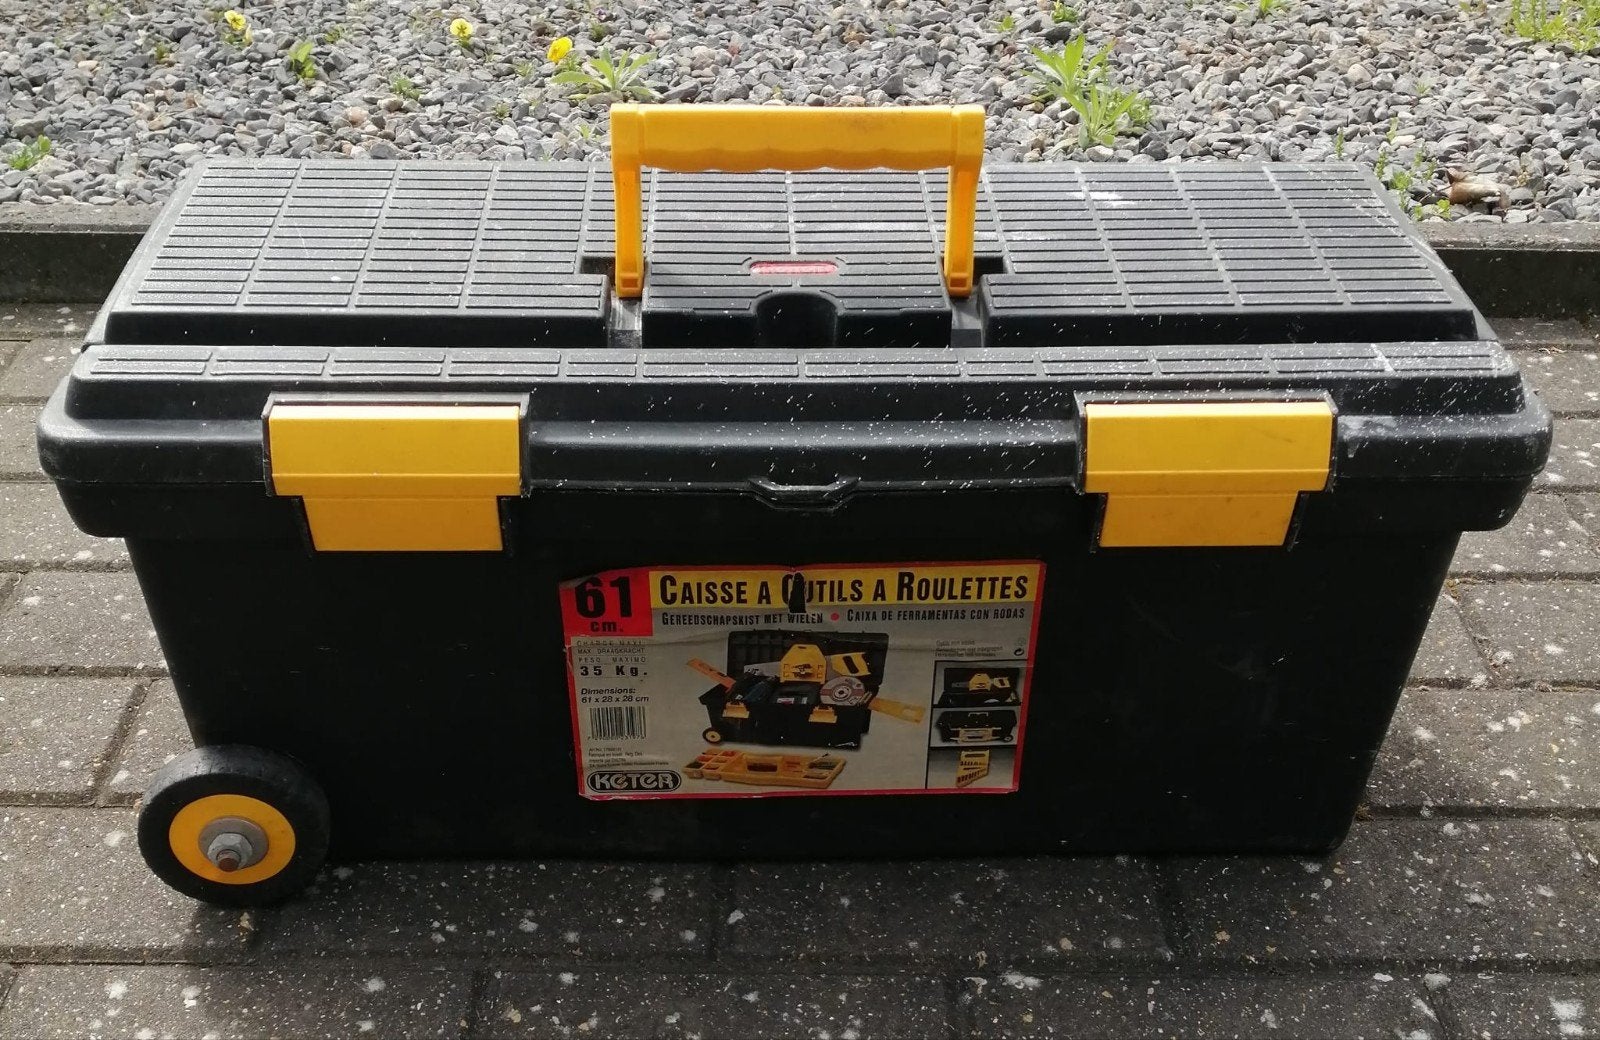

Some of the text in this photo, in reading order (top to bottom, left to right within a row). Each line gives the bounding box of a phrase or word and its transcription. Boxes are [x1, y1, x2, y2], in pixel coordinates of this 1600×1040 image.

[659, 574, 748, 606] CAISSE
[757, 580, 772, 605] A
[873, 578, 887, 602] A
[896, 571, 1029, 601] ROULETTES
[575, 576, 632, 619] 61
[661, 612, 823, 626] GEREEDSCHAPSKIST MET WIELEN
[846, 607, 1025, 622] CAIXA DE FERRAMENTAS CON RODAS
[589, 620, 624, 633] cm.
[580, 665, 648, 677] 35 Kg.
[581, 696, 592, 704] 61
[602, 695, 613, 703] 28
[594, 773, 674, 789] KETER
